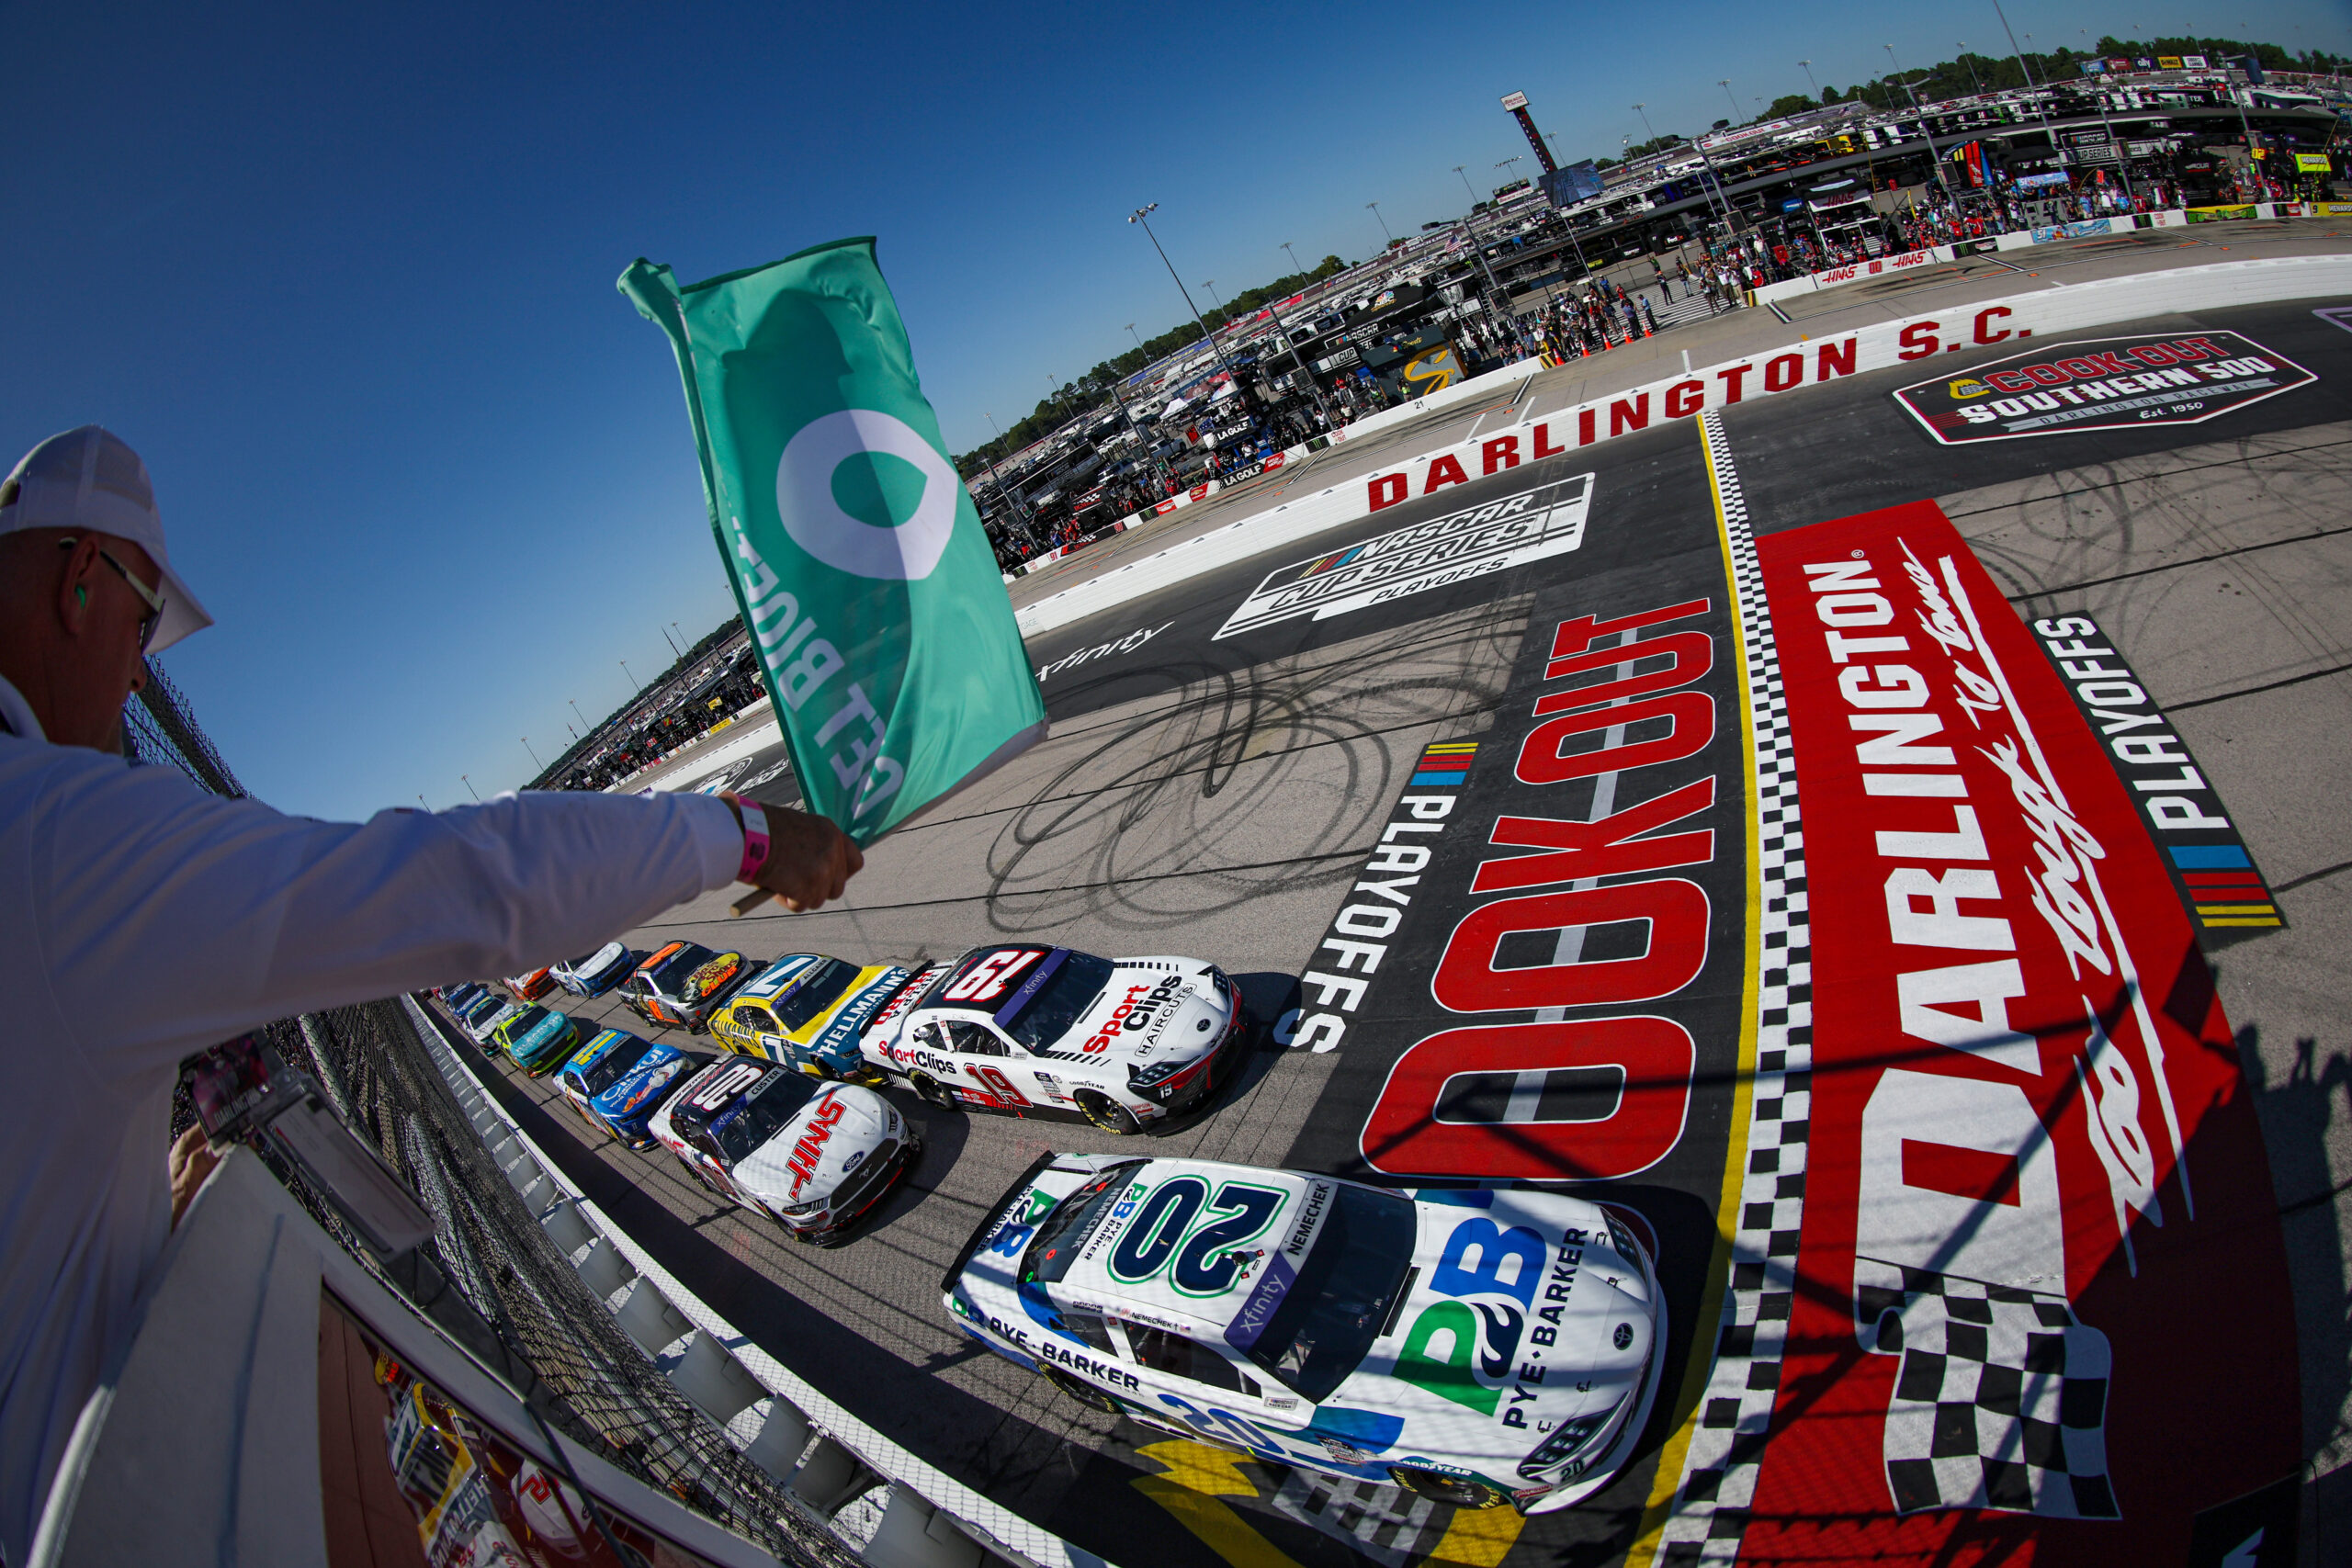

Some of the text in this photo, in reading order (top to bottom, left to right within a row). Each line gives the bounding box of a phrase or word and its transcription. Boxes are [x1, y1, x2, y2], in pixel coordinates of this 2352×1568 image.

[2088, 147, 2111, 159] SERIES
[1823, 251, 1926, 283] HAAS 00 HAAS
[1339, 348, 1355, 362] CUP
[1984, 337, 2231, 394] COOK OUT
[1368, 306, 2032, 513] DARLINGTON S.C.
[1414, 400, 1424, 410] 21
[1956, 356, 2277, 423] SOUTHERN 500
[2039, 381, 2251, 424] DARLINGTON RACEWAY
[2139, 402, 2203, 419] Est. 1950
[1217, 421, 1248, 441] LA GOLF
[1224, 465, 1261, 487] LA GOLF
[1352, 494, 1534, 561] NASCAR
[1269, 514, 1539, 610] CUP SERIES
[1369, 558, 1508, 604] PLAYOFFS
[2034, 617, 2230, 829] PLAYOFFS
[1358, 597, 1716, 1182] OOK OUT
[1272, 795, 1457, 1054] PLAYOFFS
[1803, 559, 2069, 1299] DARLINGTON
[701, 965, 738, 998] CLUB
[944, 950, 1046, 1002] 19
[1022, 969, 1047, 996] xfinity
[1082, 985, 1150, 1055] Sport
[1123, 976, 1182, 1032] Clips
[1138, 986, 1193, 1055] HAIRCUTS
[751, 1070, 780, 1095] CUSTER
[964, 1063, 1035, 1109] 19
[1159, 1085, 1173, 1100] 19
[844, 1153, 863, 1171] Ford
[1071, 1187, 1123, 1250] NEMECHEK
[1084, 1220, 1116, 1261] BARKER
[1107, 1175, 1290, 1298] 20
[1288, 1182, 1330, 1256] NEMECHEK
[1131, 1312, 1172, 1328] NEMECHEK
[1240, 1274, 1285, 1334] xfinity
